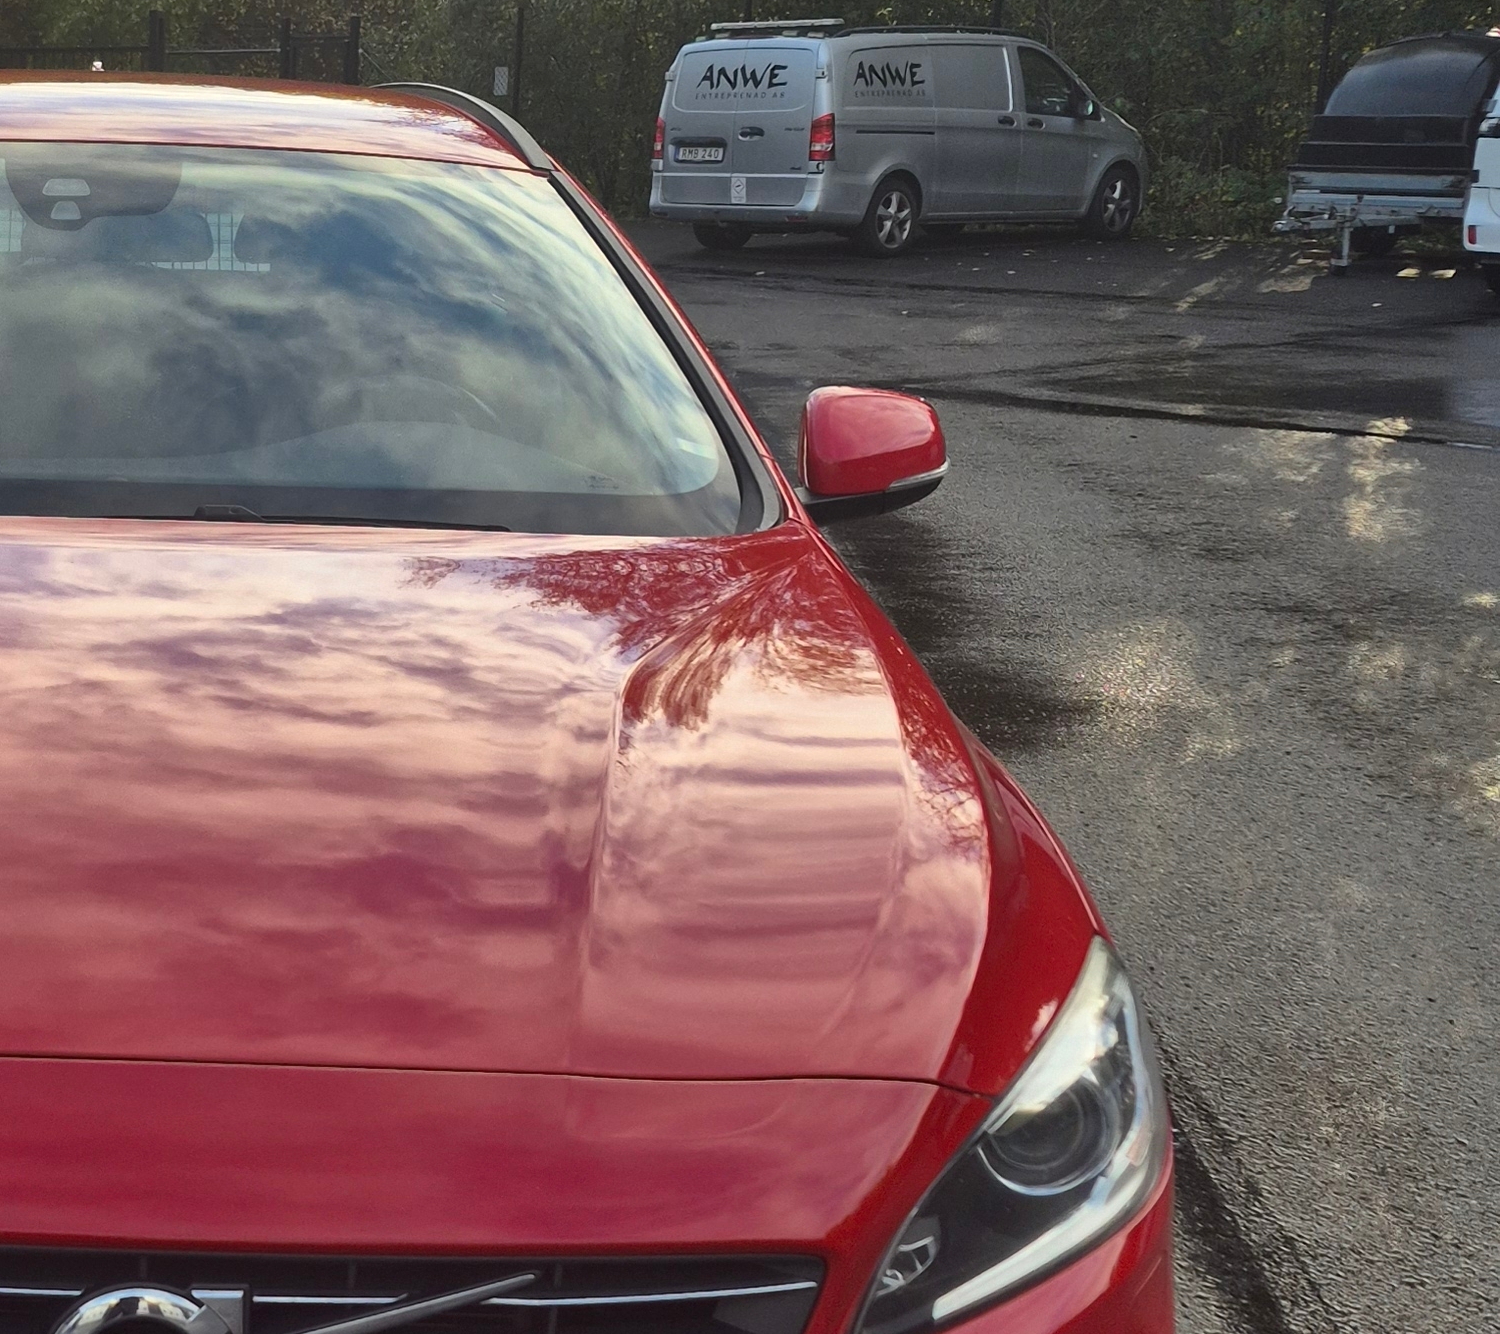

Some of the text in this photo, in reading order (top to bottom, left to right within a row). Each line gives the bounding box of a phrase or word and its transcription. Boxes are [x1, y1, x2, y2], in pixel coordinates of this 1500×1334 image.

[696, 62, 788, 91] ANWE
[853, 60, 926, 88] ANWE
[695, 91, 767, 100] ENTREPRENAD
[681, 148, 719, 159] RMB 240
